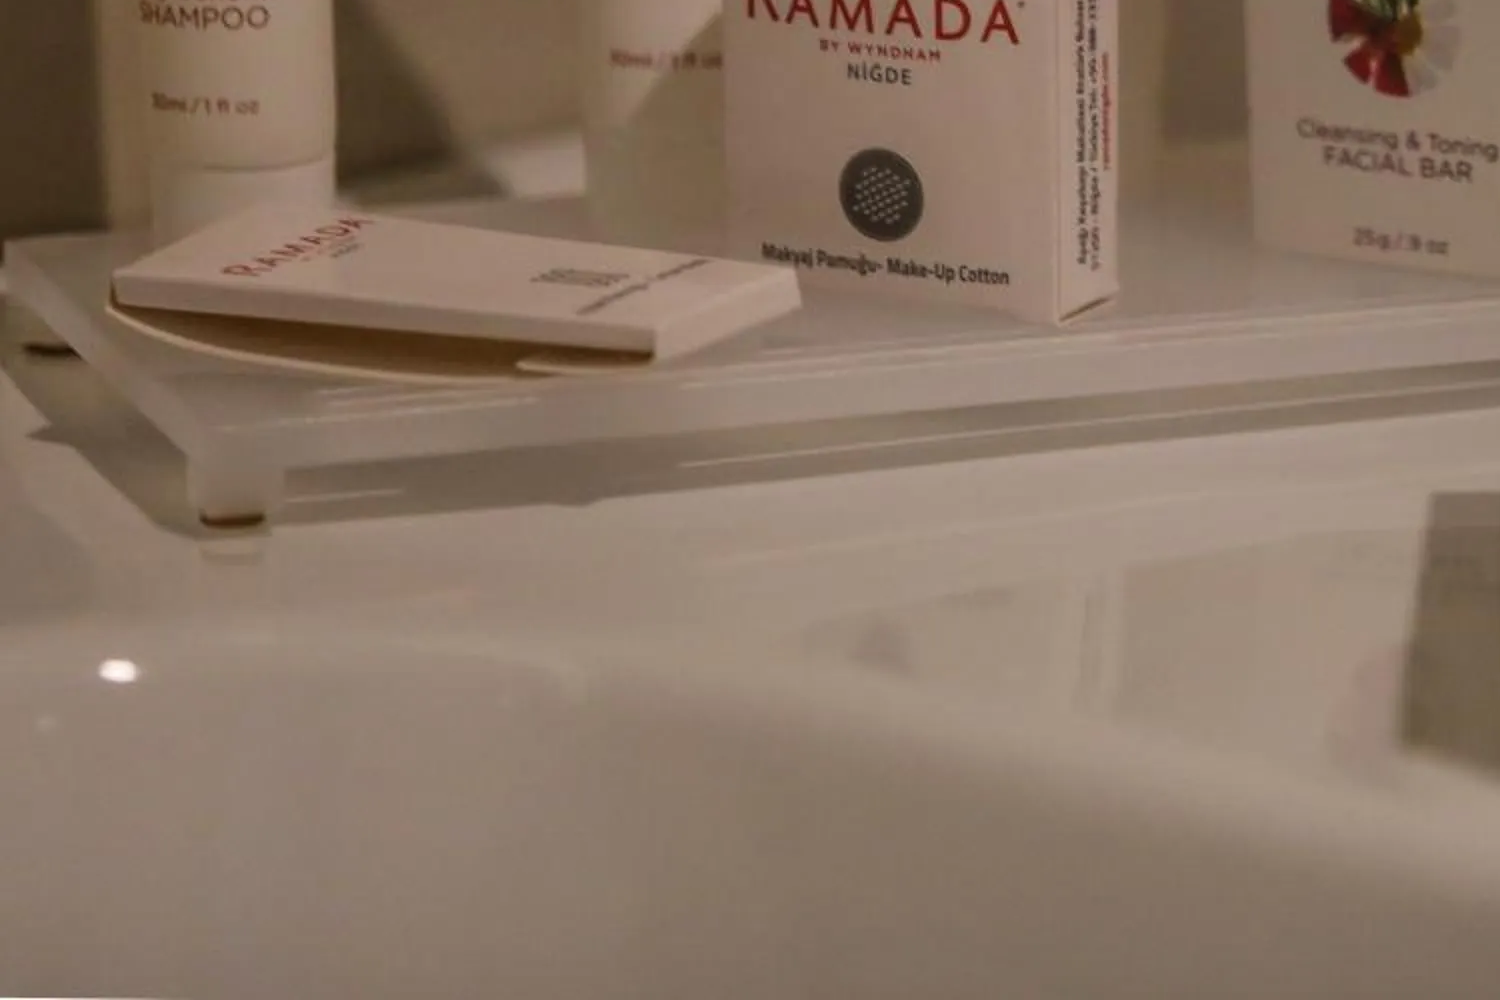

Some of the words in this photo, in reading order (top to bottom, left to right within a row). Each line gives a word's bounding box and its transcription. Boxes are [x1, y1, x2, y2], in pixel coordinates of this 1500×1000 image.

[818, 38, 840, 53] BY
[847, 40, 942, 64] WYNDHAM
[1405, 129, 1422, 151] &
[1427, 131, 1500, 163] Toning
[1322, 145, 1414, 177] FACIAL
[1418, 155, 1475, 183] BAR
[886, 256, 955, 287] Make-Up
[958, 264, 1010, 285] Cotton
